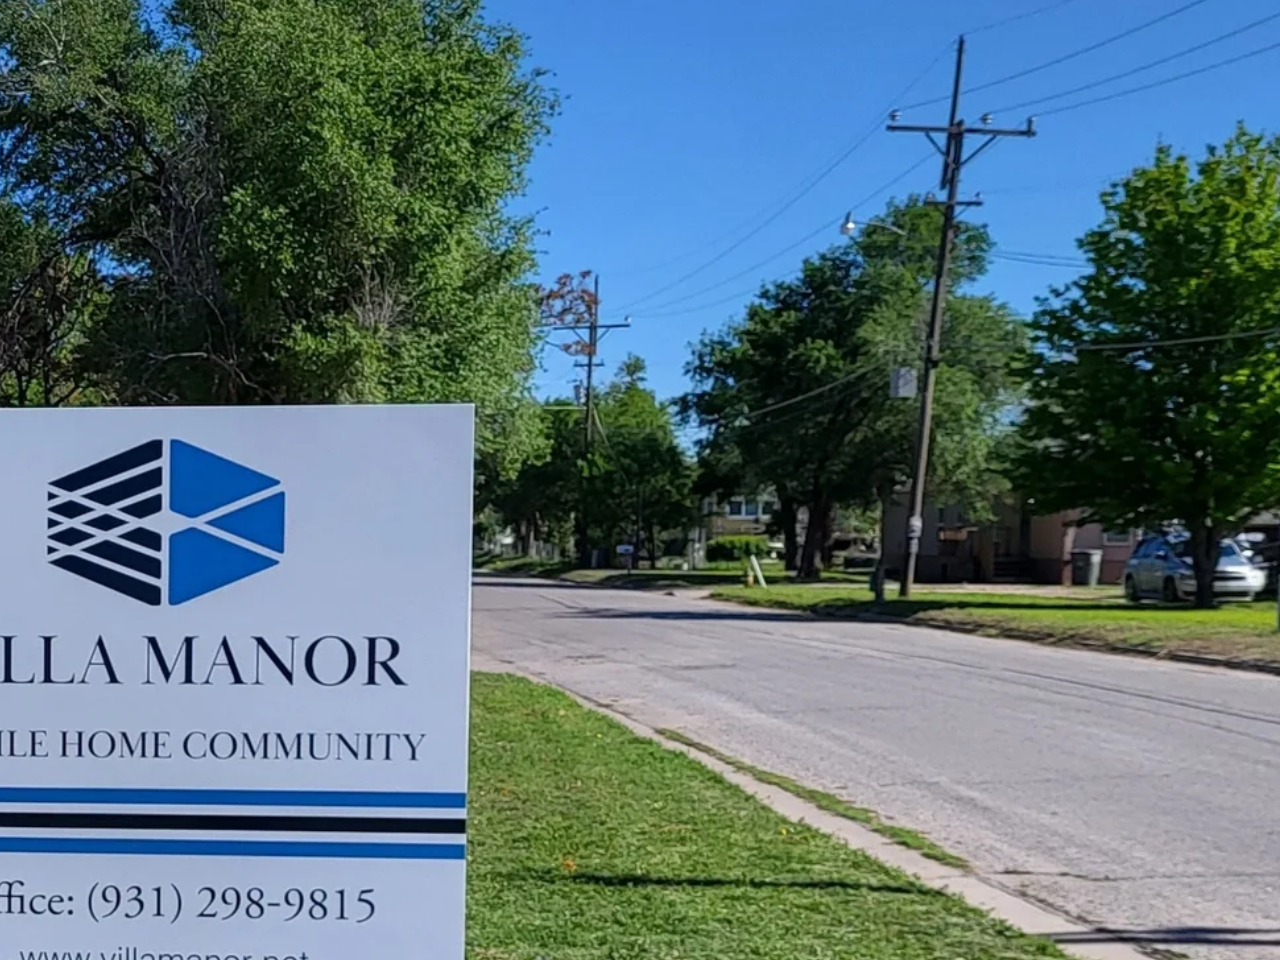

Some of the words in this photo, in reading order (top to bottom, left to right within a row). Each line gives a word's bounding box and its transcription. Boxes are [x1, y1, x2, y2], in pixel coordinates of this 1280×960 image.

[141, 635, 409, 687] MANOR
[59, 730, 173, 759] HOME
[182, 730, 427, 762] COMMUNITY
[87, 882, 183, 924] (931)
[195, 886, 376, 923] 298-9815
